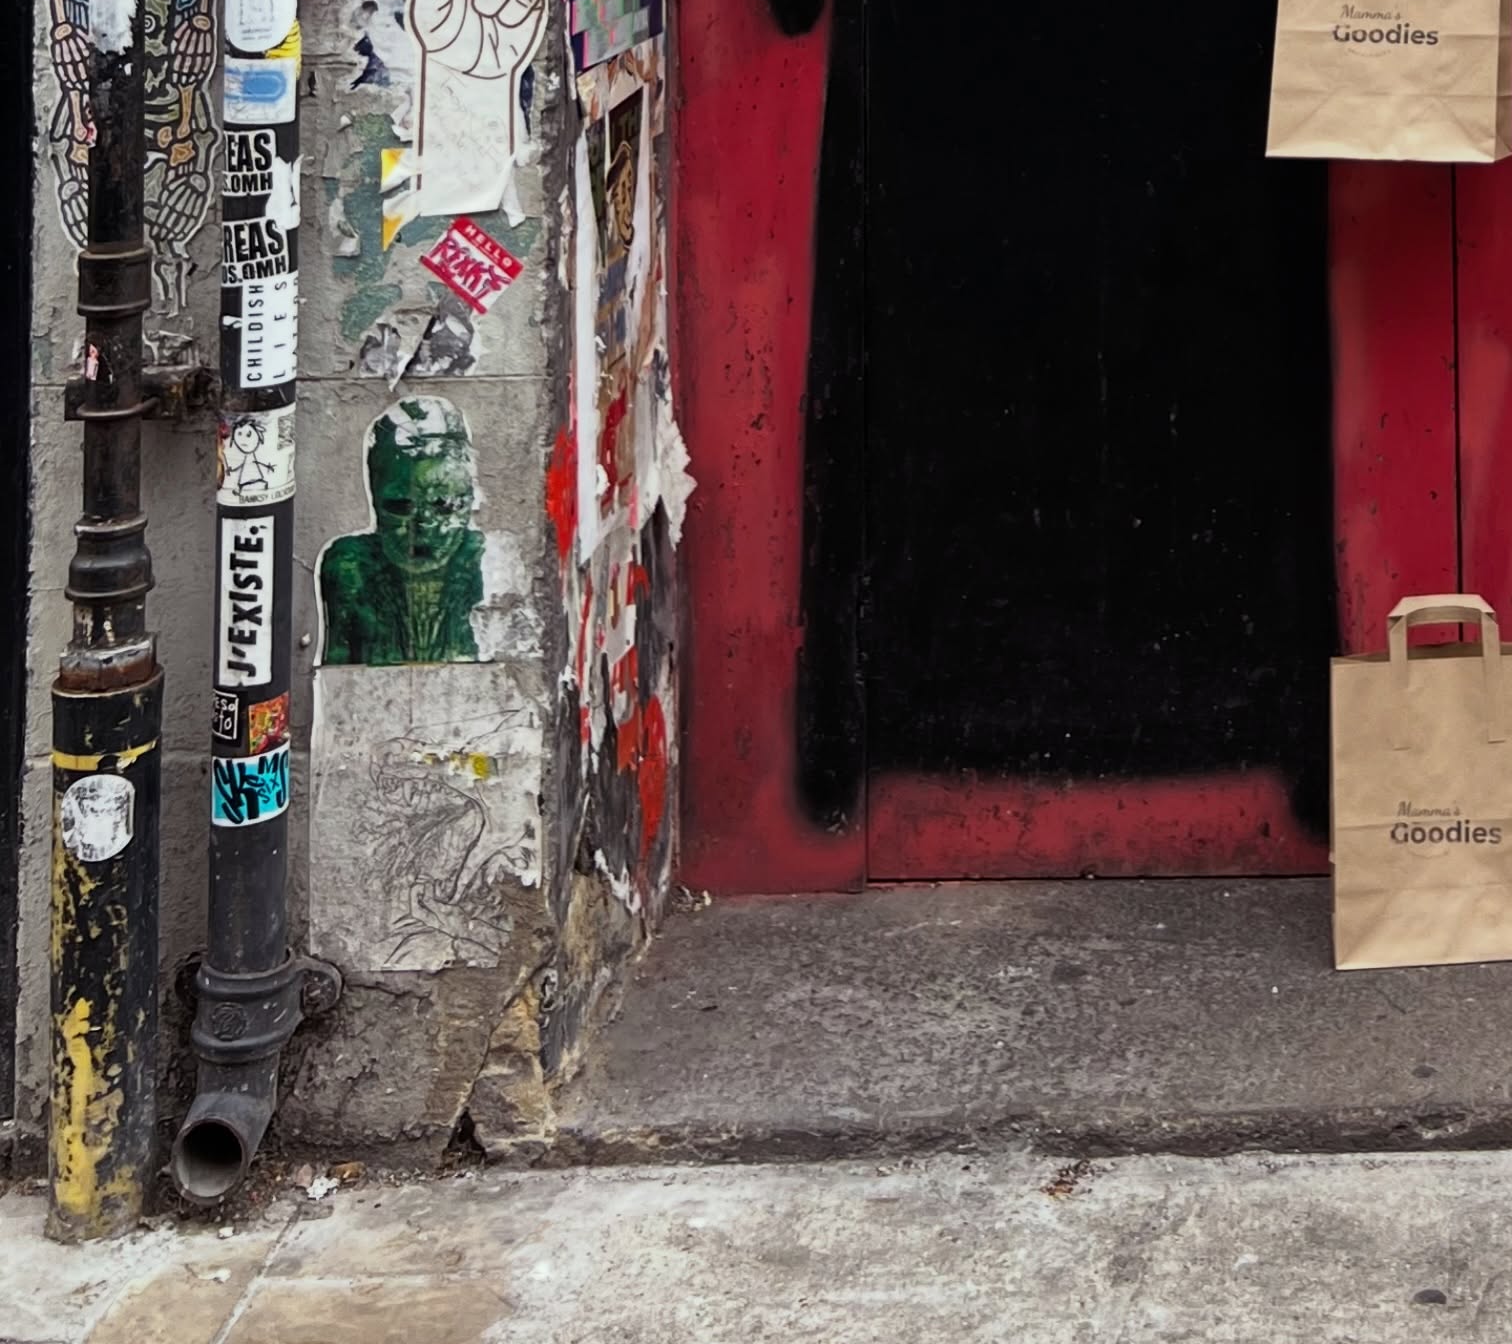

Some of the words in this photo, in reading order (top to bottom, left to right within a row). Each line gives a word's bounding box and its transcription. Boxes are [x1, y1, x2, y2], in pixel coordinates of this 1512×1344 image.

[1340, 3, 1402, 20] Mamma's
[1332, 23, 1439, 45] Goodies
[464, 223, 514, 269] HELLO
[247, 285, 264, 382] CHILDISH
[1391, 819, 1502, 845] Goodies
